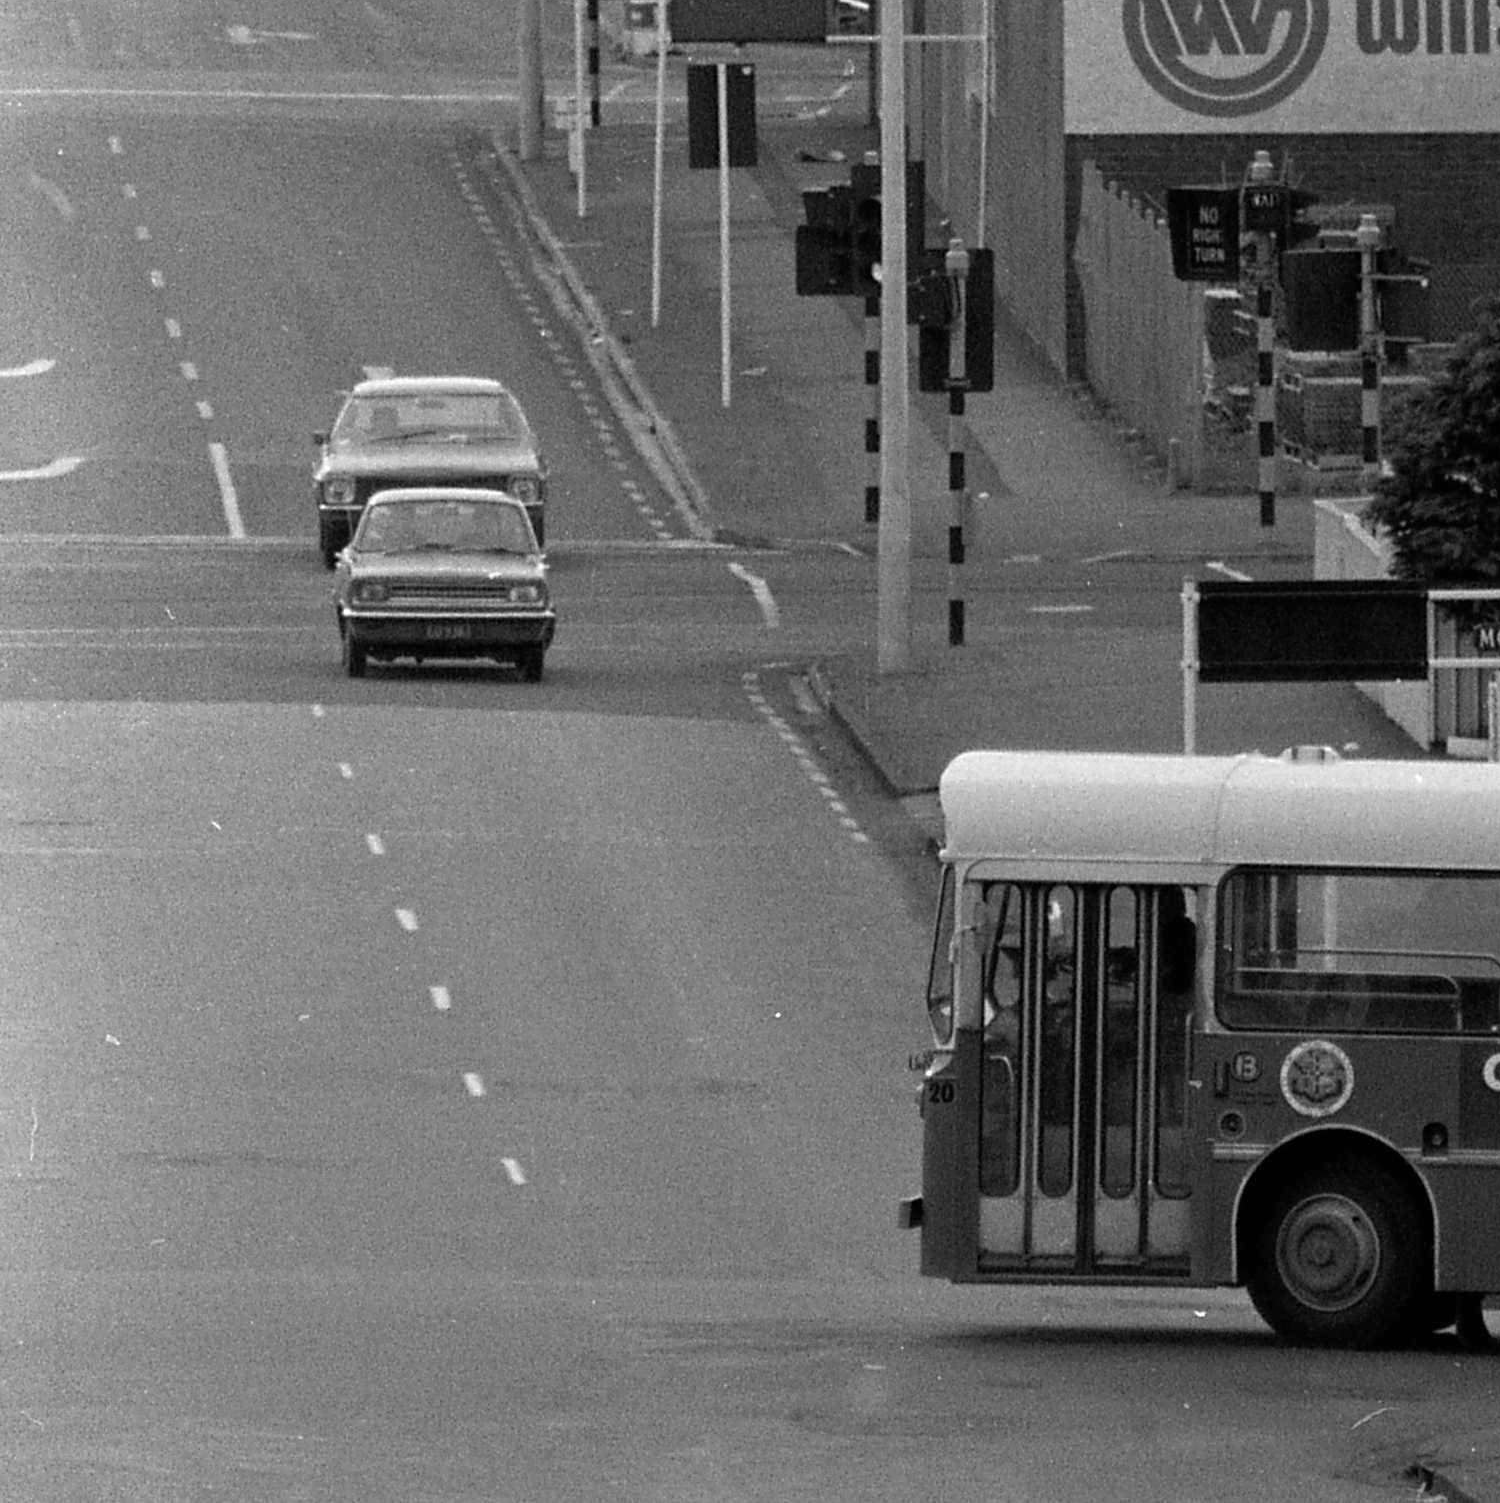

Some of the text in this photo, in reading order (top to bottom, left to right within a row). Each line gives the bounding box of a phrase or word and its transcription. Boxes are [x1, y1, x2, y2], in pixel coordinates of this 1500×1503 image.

[1199, 206, 1220, 226] NO
[1194, 247, 1226, 264] TURN
[928, 1080, 955, 1104] 20
